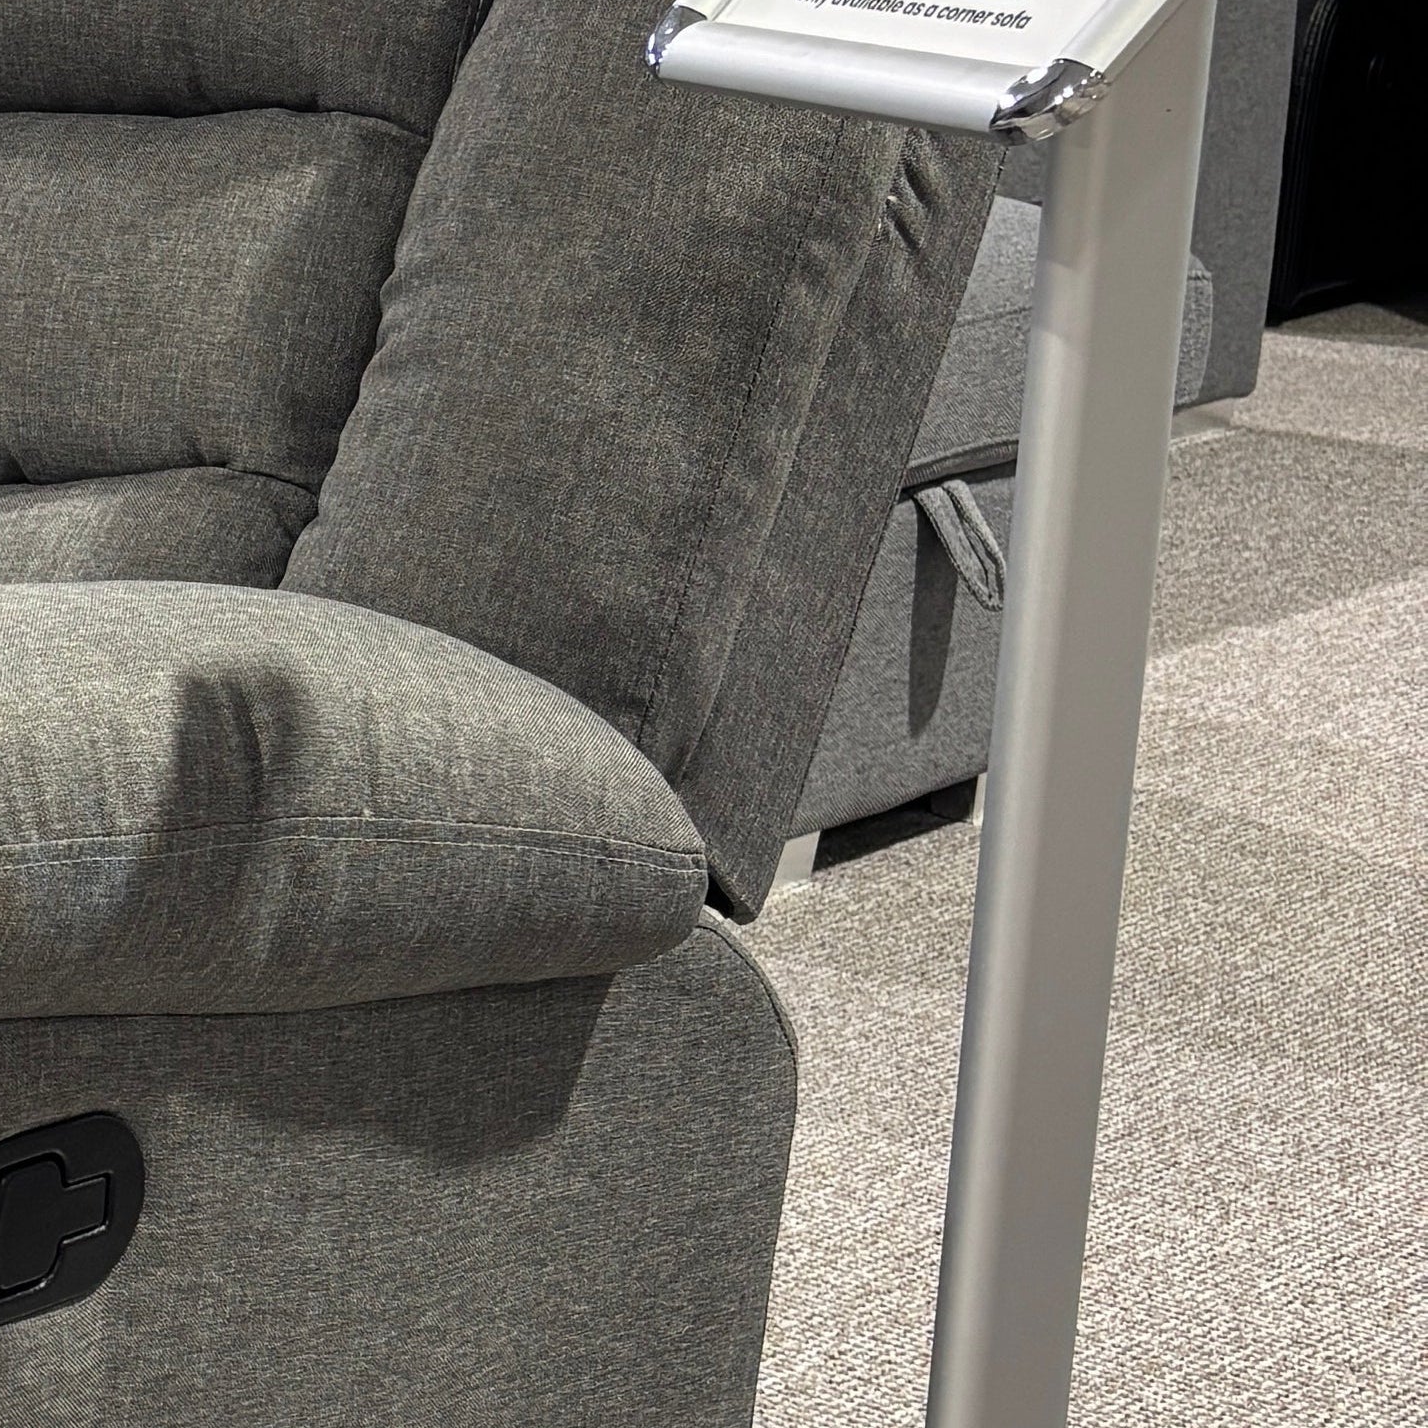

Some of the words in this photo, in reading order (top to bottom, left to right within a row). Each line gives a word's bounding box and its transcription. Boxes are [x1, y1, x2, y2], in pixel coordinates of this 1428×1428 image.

[902, 1, 924, 16] as
[923, 4, 938, 18] a
[936, 5, 993, 25] corner
[990, 10, 1033, 30] sofa
